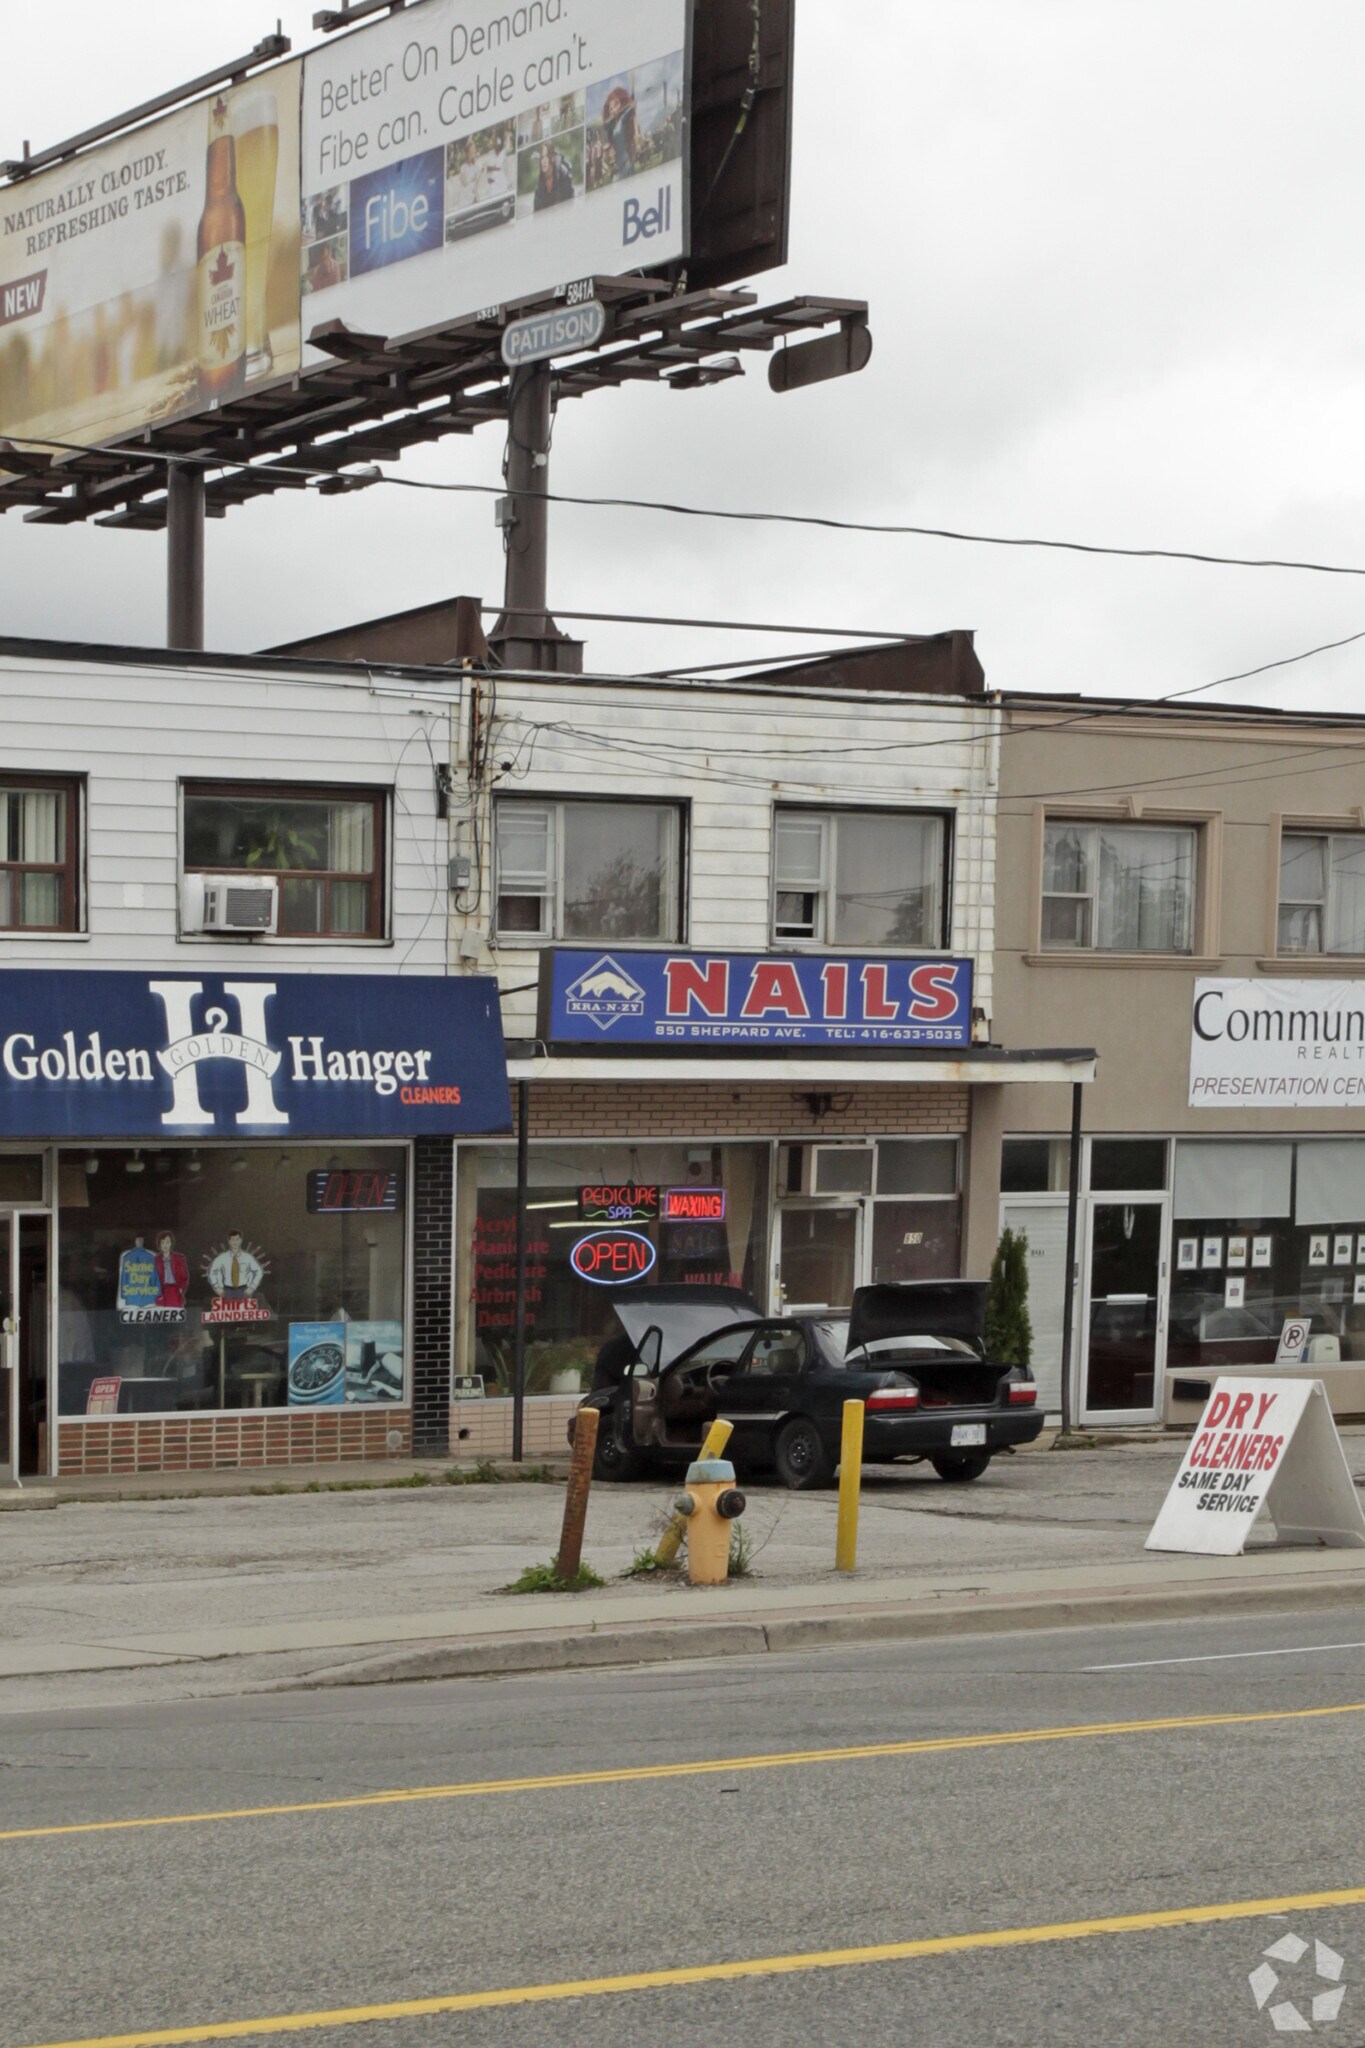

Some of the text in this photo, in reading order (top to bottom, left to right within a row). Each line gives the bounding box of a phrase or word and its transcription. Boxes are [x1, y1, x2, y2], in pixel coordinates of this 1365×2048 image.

[320, 0, 568, 119] Better On Demand.
[319, 33, 593, 175] Fibe can. Cable can't.
[4, 149, 169, 236] NATURALLY CLOUDY.
[26, 170, 191, 257] REFRESHING TASTE.
[365, 188, 429, 250] Fibe
[622, 184, 672, 247] Bell
[4, 279, 41, 318] NEW
[566, 278, 594, 305] 5841A
[204, 297, 241, 328] WHEAT
[511, 311, 594, 355] PATTISON
[664, 958, 960, 1022] NAILS
[571, 1001, 640, 1013] KRA-N-ZY
[655, 1025, 962, 1040] 850 SHEPPARD AVE. TEL: 416-633-5035
[3, 1030, 432, 1096] Golden Hanger
[170, 1037, 269, 1067] GOLDEN
[400, 1086, 461, 1105] CLEANERS
[1192, 1077, 1329, 1095] PRESENTATION
[323, 1172, 389, 1208] OPEN
[581, 1186, 657, 1206] PEDICURE
[608, 1206, 632, 1219] SPA
[668, 1194, 722, 1218] WAXING
[903, 1232, 923, 1244] 850
[125, 1261, 154, 1273] Same
[575, 1242, 645, 1272] OPEN
[123, 1284, 158, 1296] Service
[130, 1272, 150, 1284] Day
[120, 1309, 186, 1323] CLEANERS
[202, 1310, 270, 1324] LAUNDERED
[211, 1297, 258, 1312] Shirts
[95, 1384, 115, 1394] OPEN
[1204, 1392, 1278, 1429] DRY
[1190, 1432, 1284, 1471] CLEANERS
[1178, 1471, 1254, 1491] SAME DAY
[1197, 1493, 1259, 1513] SERVICE
